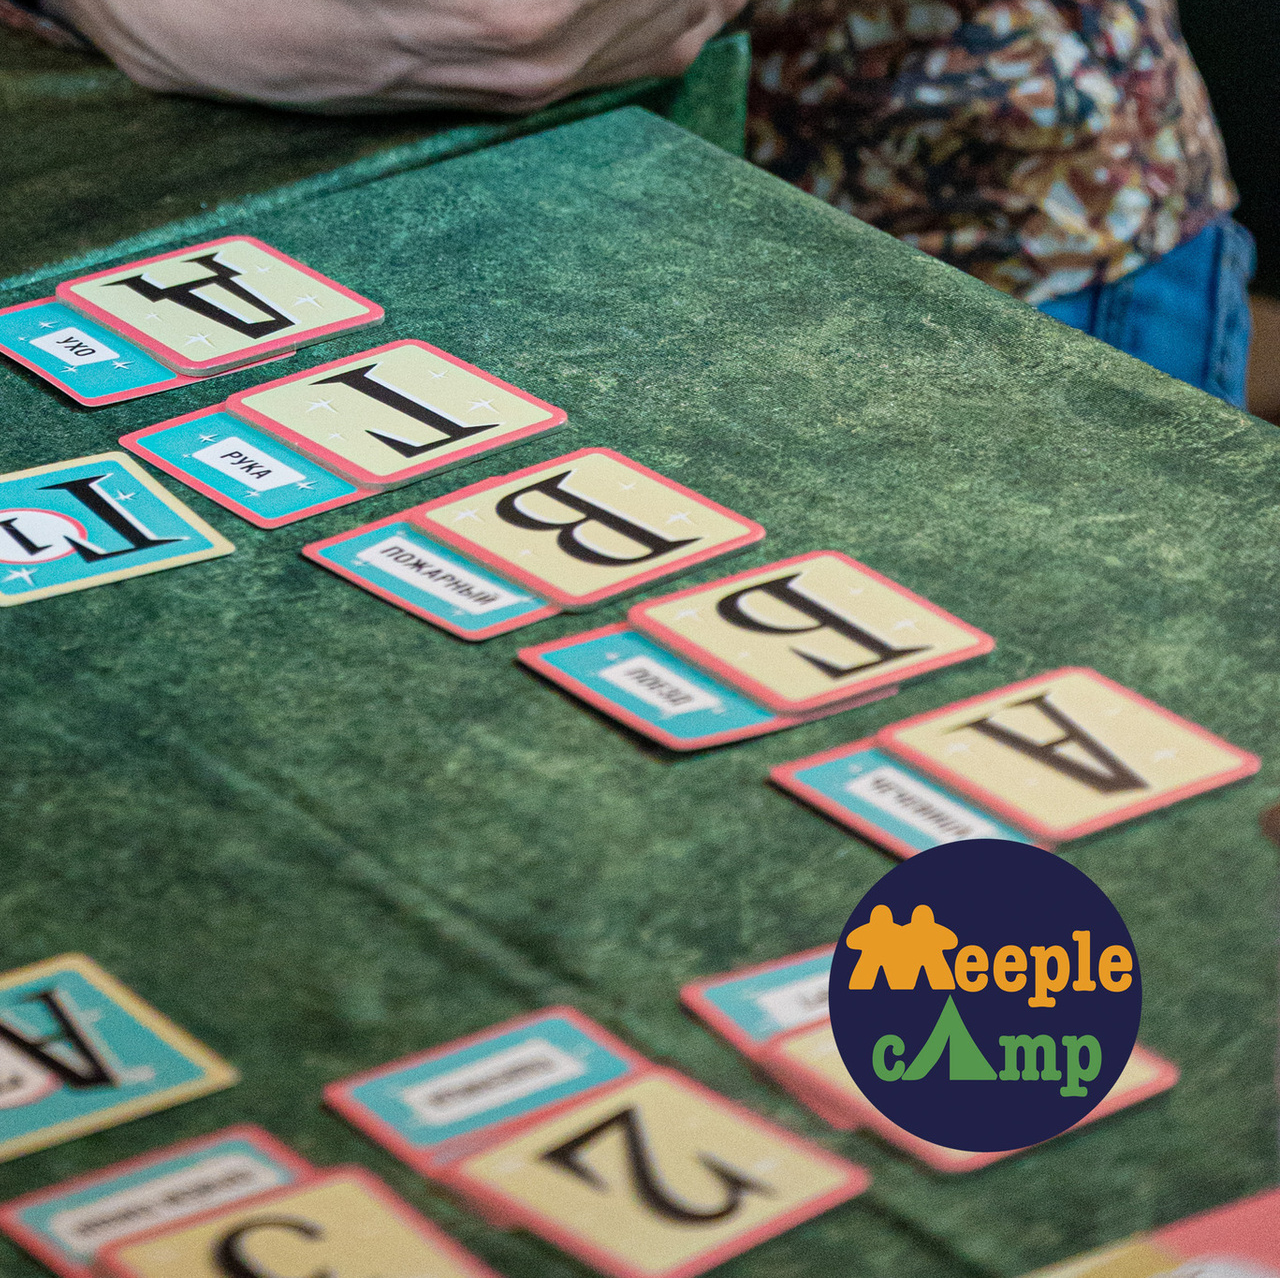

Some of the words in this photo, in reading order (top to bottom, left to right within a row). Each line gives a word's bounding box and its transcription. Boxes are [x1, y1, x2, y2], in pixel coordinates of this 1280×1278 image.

[101, 252, 296, 339] Д
[56, 336, 96, 357] УХО
[307, 363, 500, 458] Г
[220, 451, 272, 479] РУКА
[495, 470, 702, 566] В
[380, 546, 499, 605] ПОЖАРНЫЙ
[716, 573, 934, 679] Б
[941, 694, 1149, 794] А
[538, 1105, 776, 1228] 2
